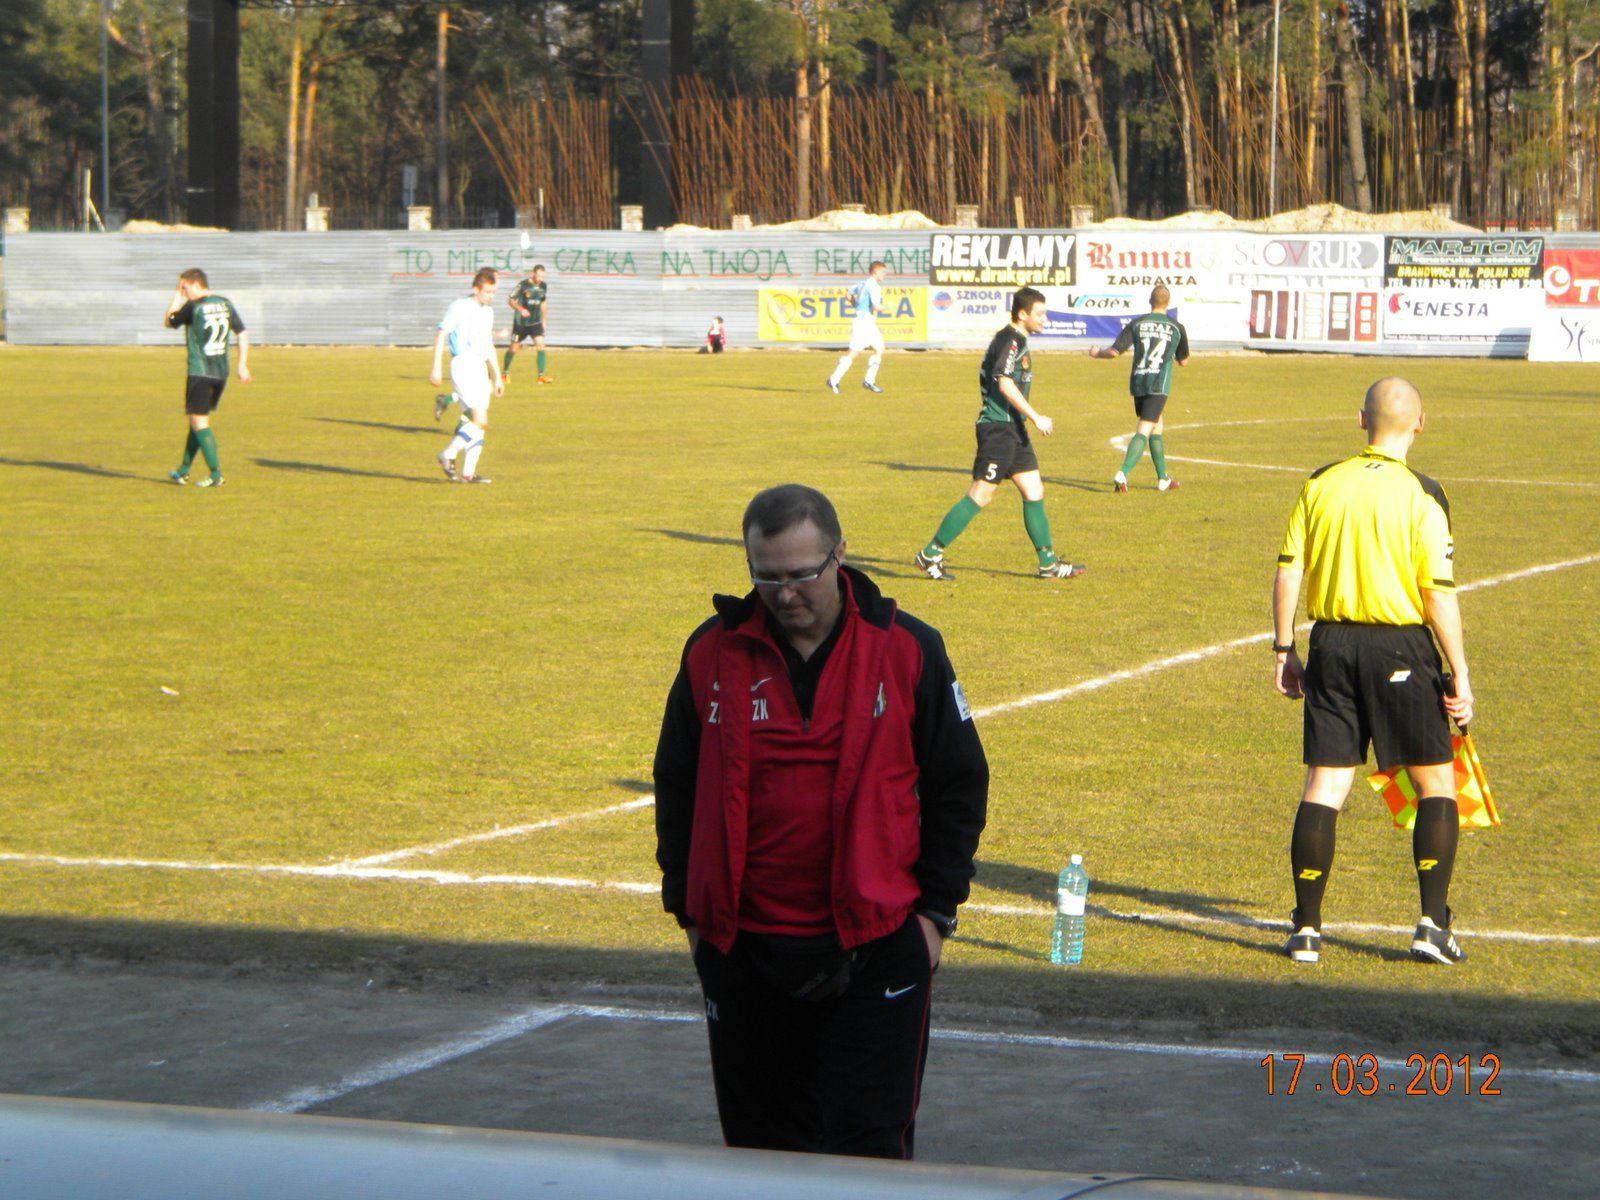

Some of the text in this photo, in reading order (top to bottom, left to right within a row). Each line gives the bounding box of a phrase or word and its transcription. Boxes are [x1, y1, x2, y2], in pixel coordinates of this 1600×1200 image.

[931, 234, 1076, 267] REKLAMY
[1391, 238, 1543, 256] MAR-TOM
[397, 247, 433, 273] TO
[554, 248, 637, 273] CZEKA
[660, 249, 695, 275] NA
[935, 266, 1071, 286] www.drukgraf.pl
[1107, 275, 1197, 286] ZAPRASZA
[956, 290, 1002, 300] SZKOŁA
[1573, 279, 1600, 303] T
[799, 297, 915, 318] STELA
[961, 304, 997, 314] JAZDY
[203, 318, 229, 350] 22
[1136, 338, 1167, 369] 14
[985, 462, 998, 481] 5
[707, 700, 720, 724] Z
[752, 698, 769, 721] ZK
